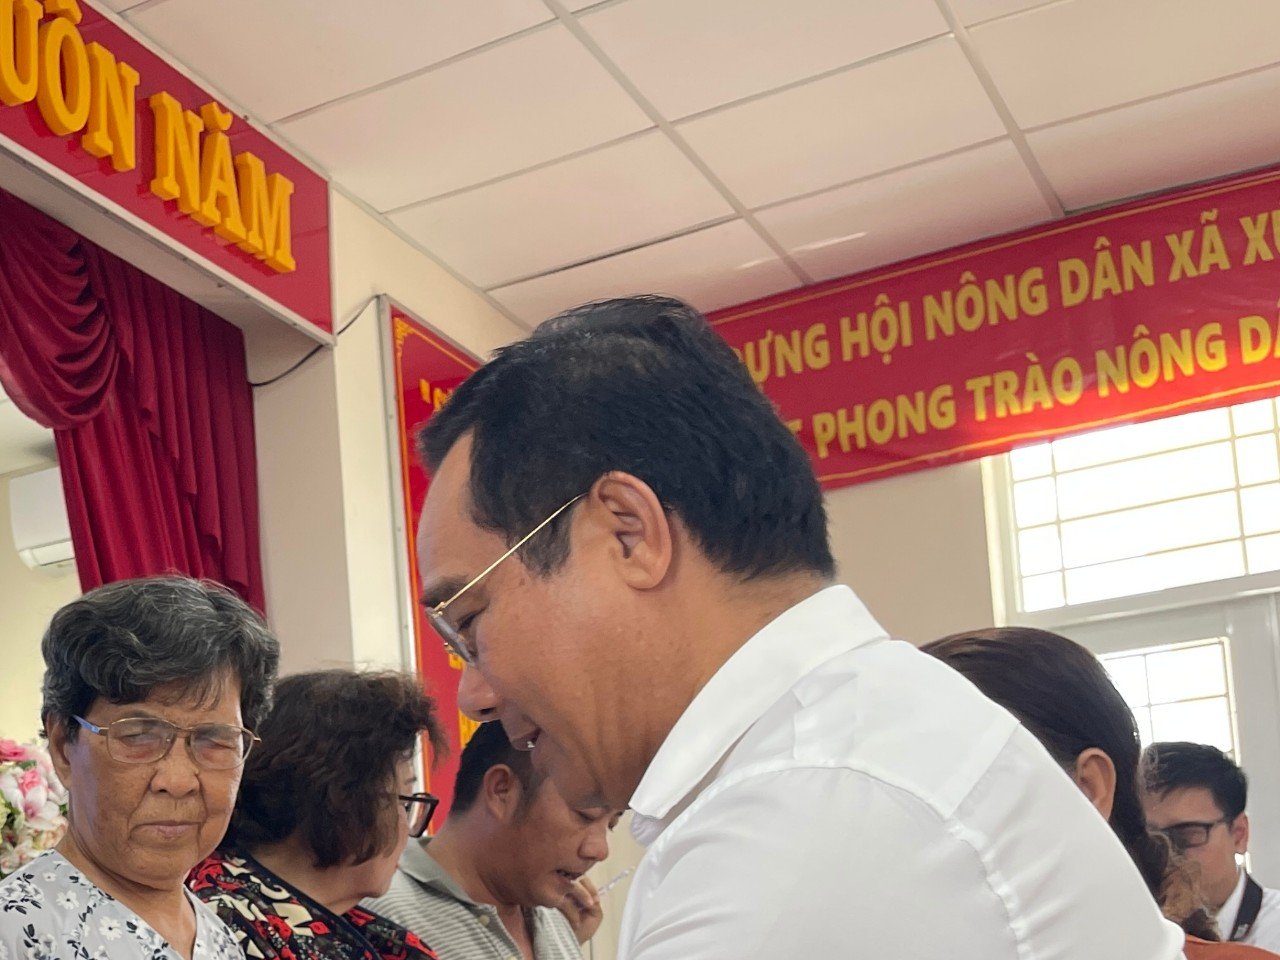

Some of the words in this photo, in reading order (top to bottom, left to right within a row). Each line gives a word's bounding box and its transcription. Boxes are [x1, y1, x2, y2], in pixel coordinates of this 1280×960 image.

[150, 91, 296, 273] NĂM
[840, 291, 913, 365] HỘI
[923, 271, 1048, 341] NÔNG
[1058, 236, 1155, 308] DÂN
[1165, 208, 1231, 282] XÃ
[812, 384, 956, 459] PHONG
[965, 351, 1084, 423] TRÀO
[1096, 324, 1228, 398] NÔNG
[1238, 299, 1280, 365] D
